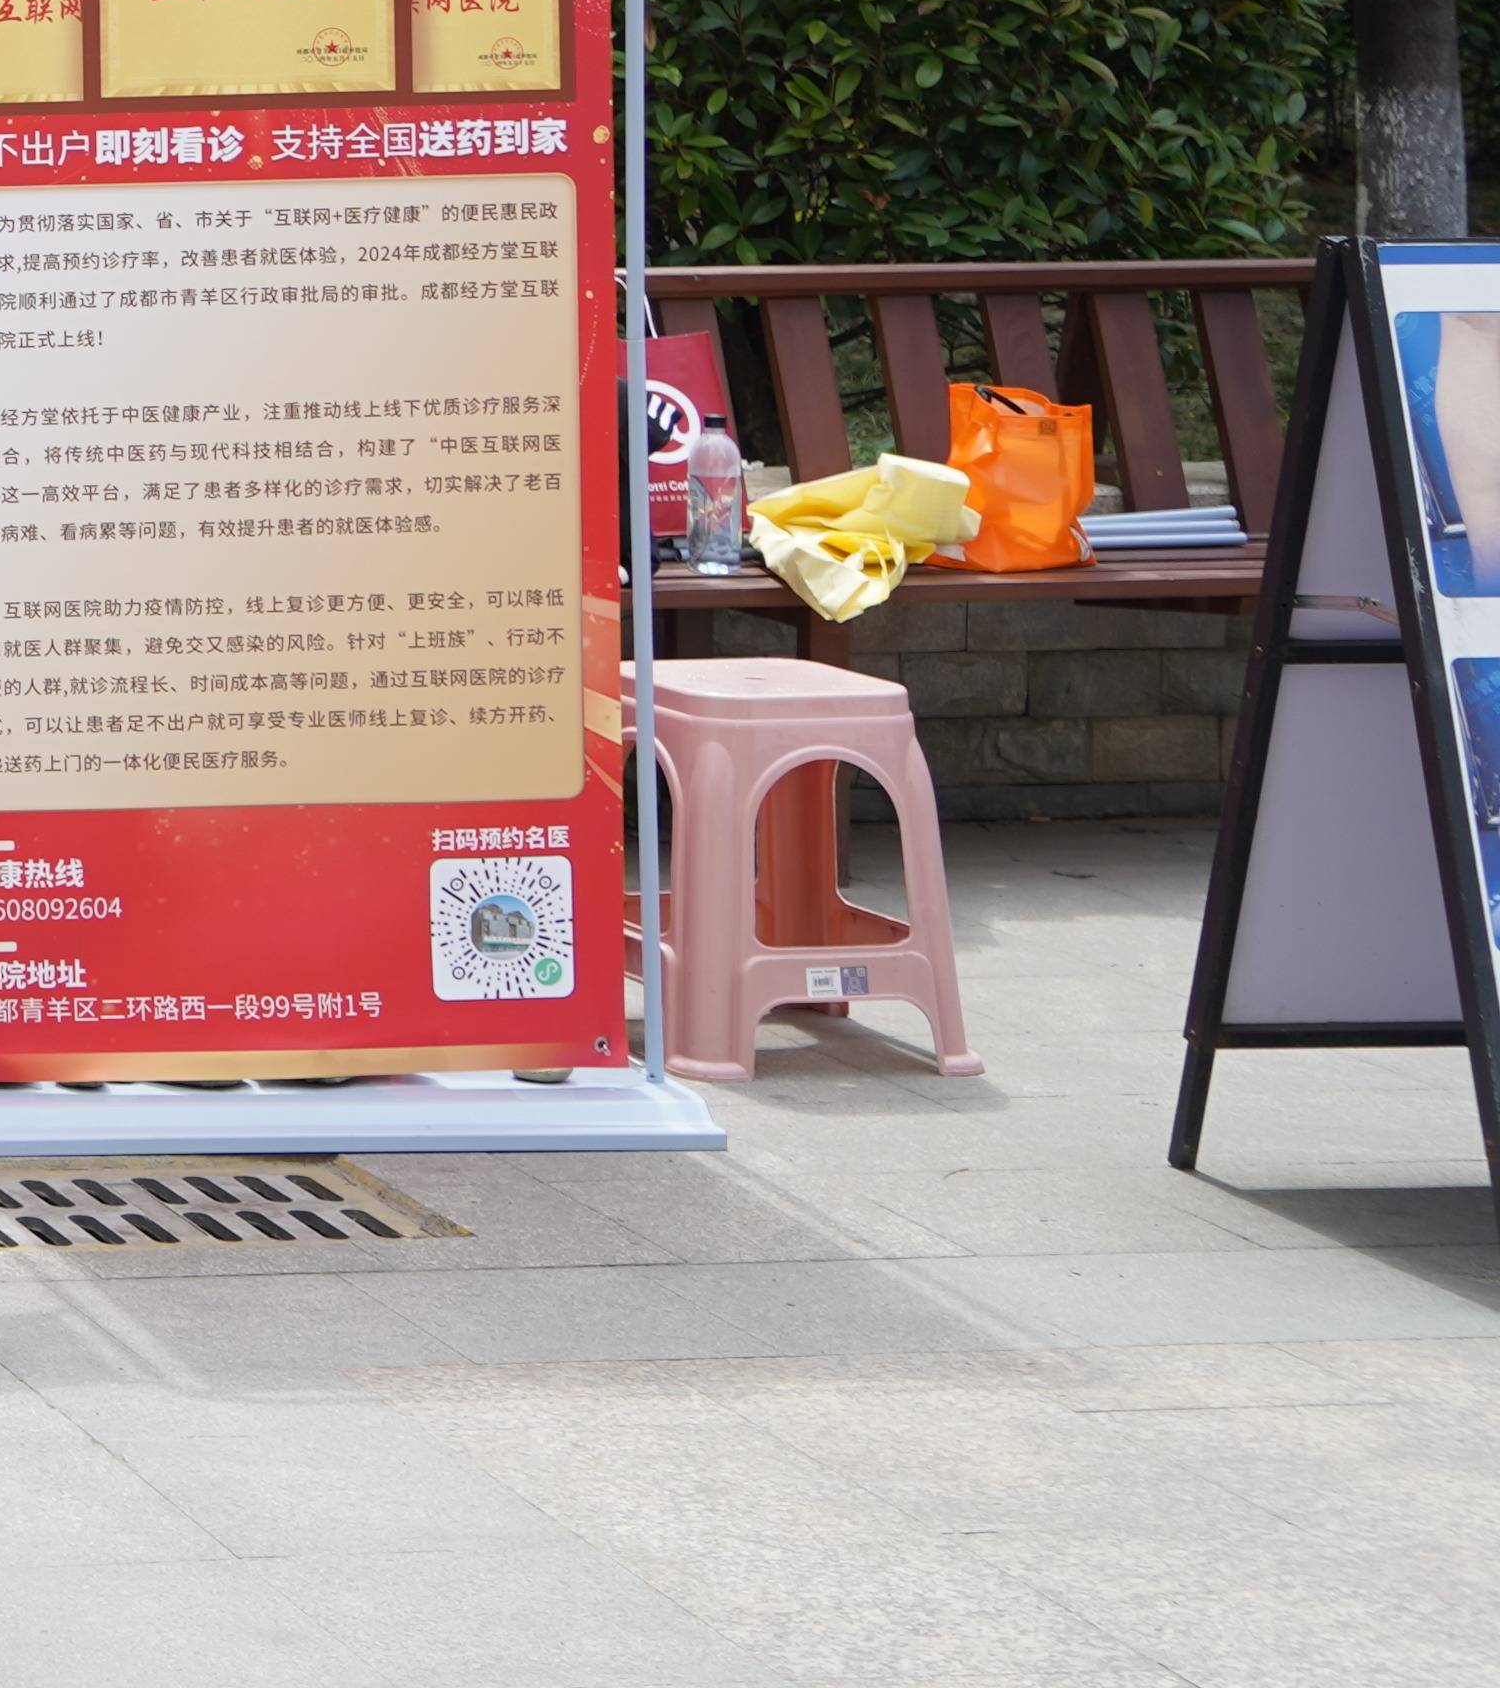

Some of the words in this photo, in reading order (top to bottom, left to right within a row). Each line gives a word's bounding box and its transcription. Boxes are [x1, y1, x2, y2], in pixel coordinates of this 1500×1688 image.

[272, 119, 567, 161] 支持全国送药到家
[0, 396, 560, 427] 经方堂依托于中医健康产业，注重推动线上线下优质诊疗服务深
[431, 825, 570, 853] 扫码预约名医
